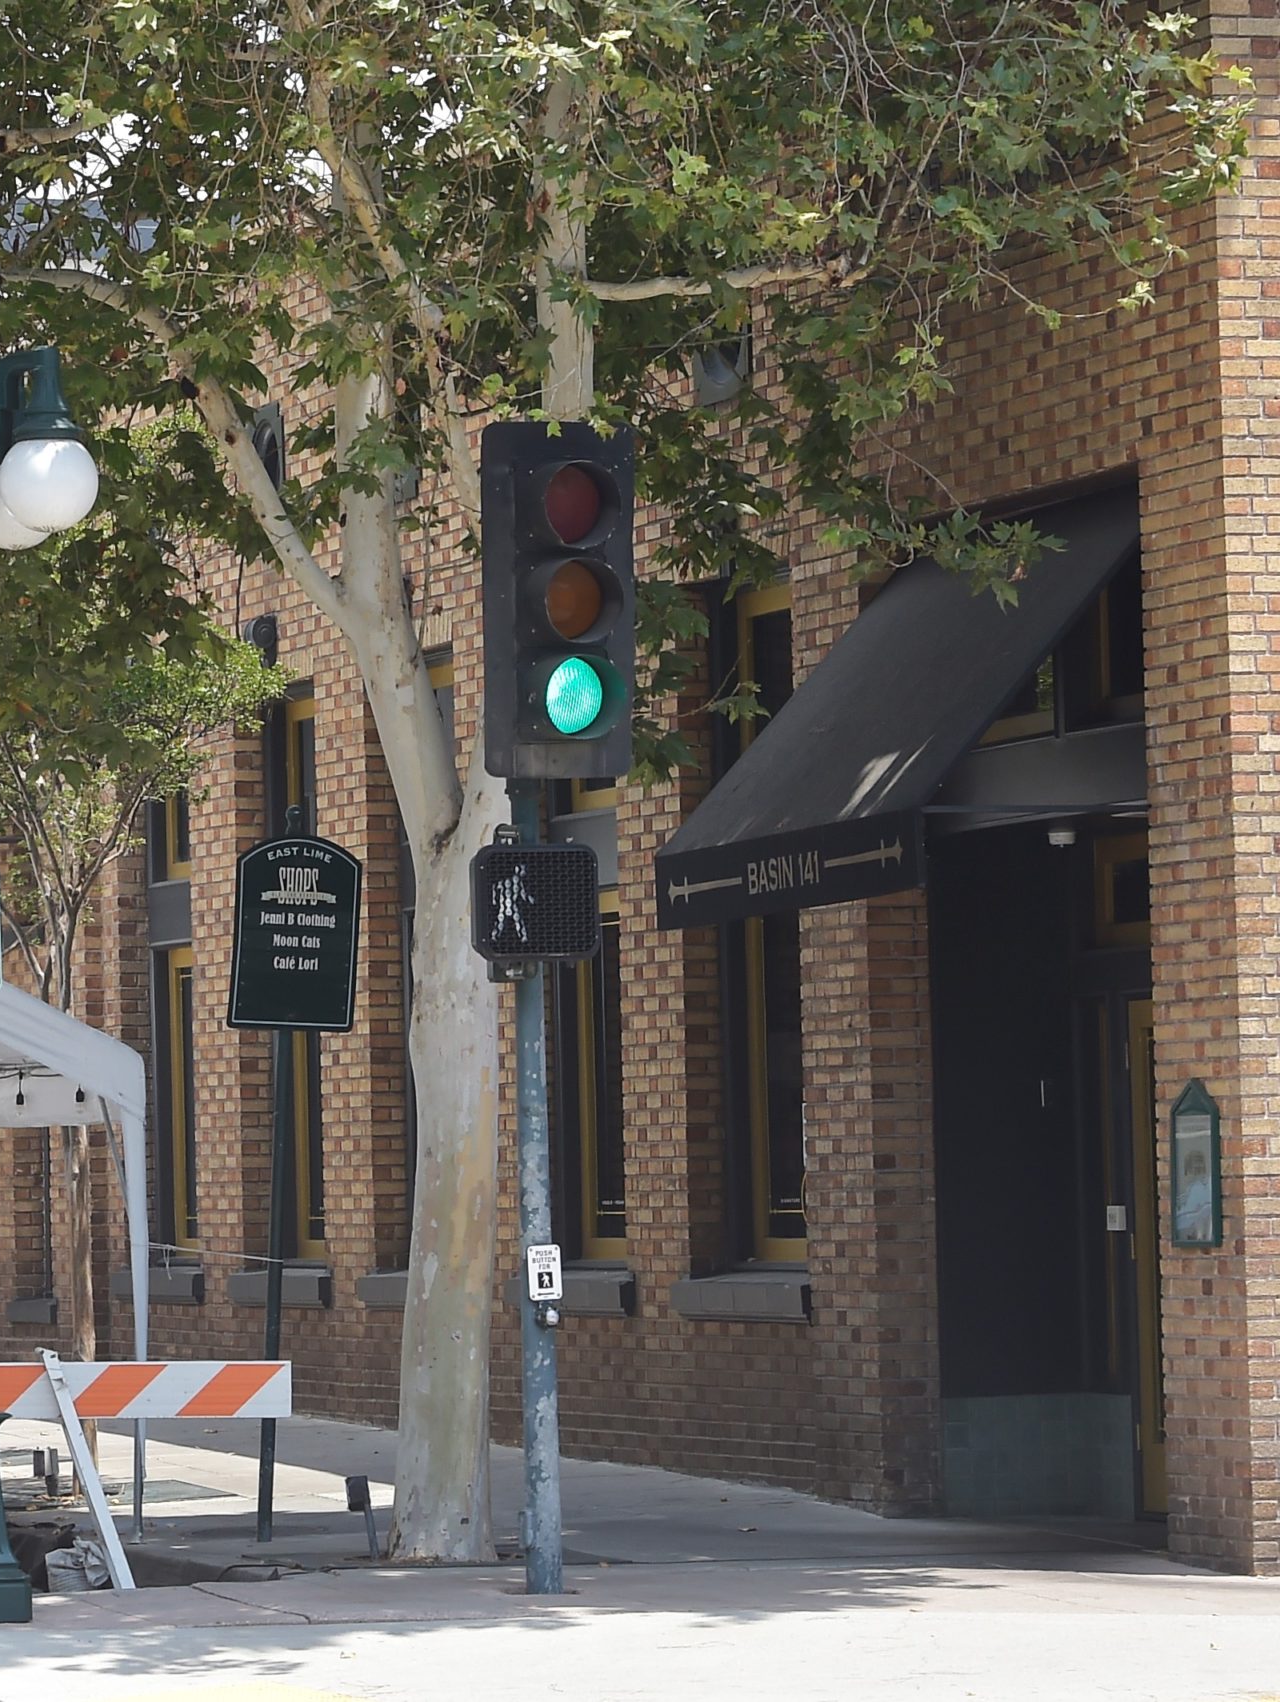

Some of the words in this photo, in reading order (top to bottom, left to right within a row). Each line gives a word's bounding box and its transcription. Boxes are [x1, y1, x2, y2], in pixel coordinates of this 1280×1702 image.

[267, 846, 299, 861] EAST
[303, 847, 332, 864] LIME
[747, 855, 793, 894] BASIN
[798, 850, 819, 886] 141
[278, 866, 319, 906] SHOPS
[260, 911, 286, 926] Jenni
[287, 913, 295, 926] B
[297, 913, 336, 929] Clothing
[272, 933, 299, 947] Moon
[301, 935, 321, 949] Cats
[273, 956, 296, 970] Café
[297, 957, 319, 971] Lori
